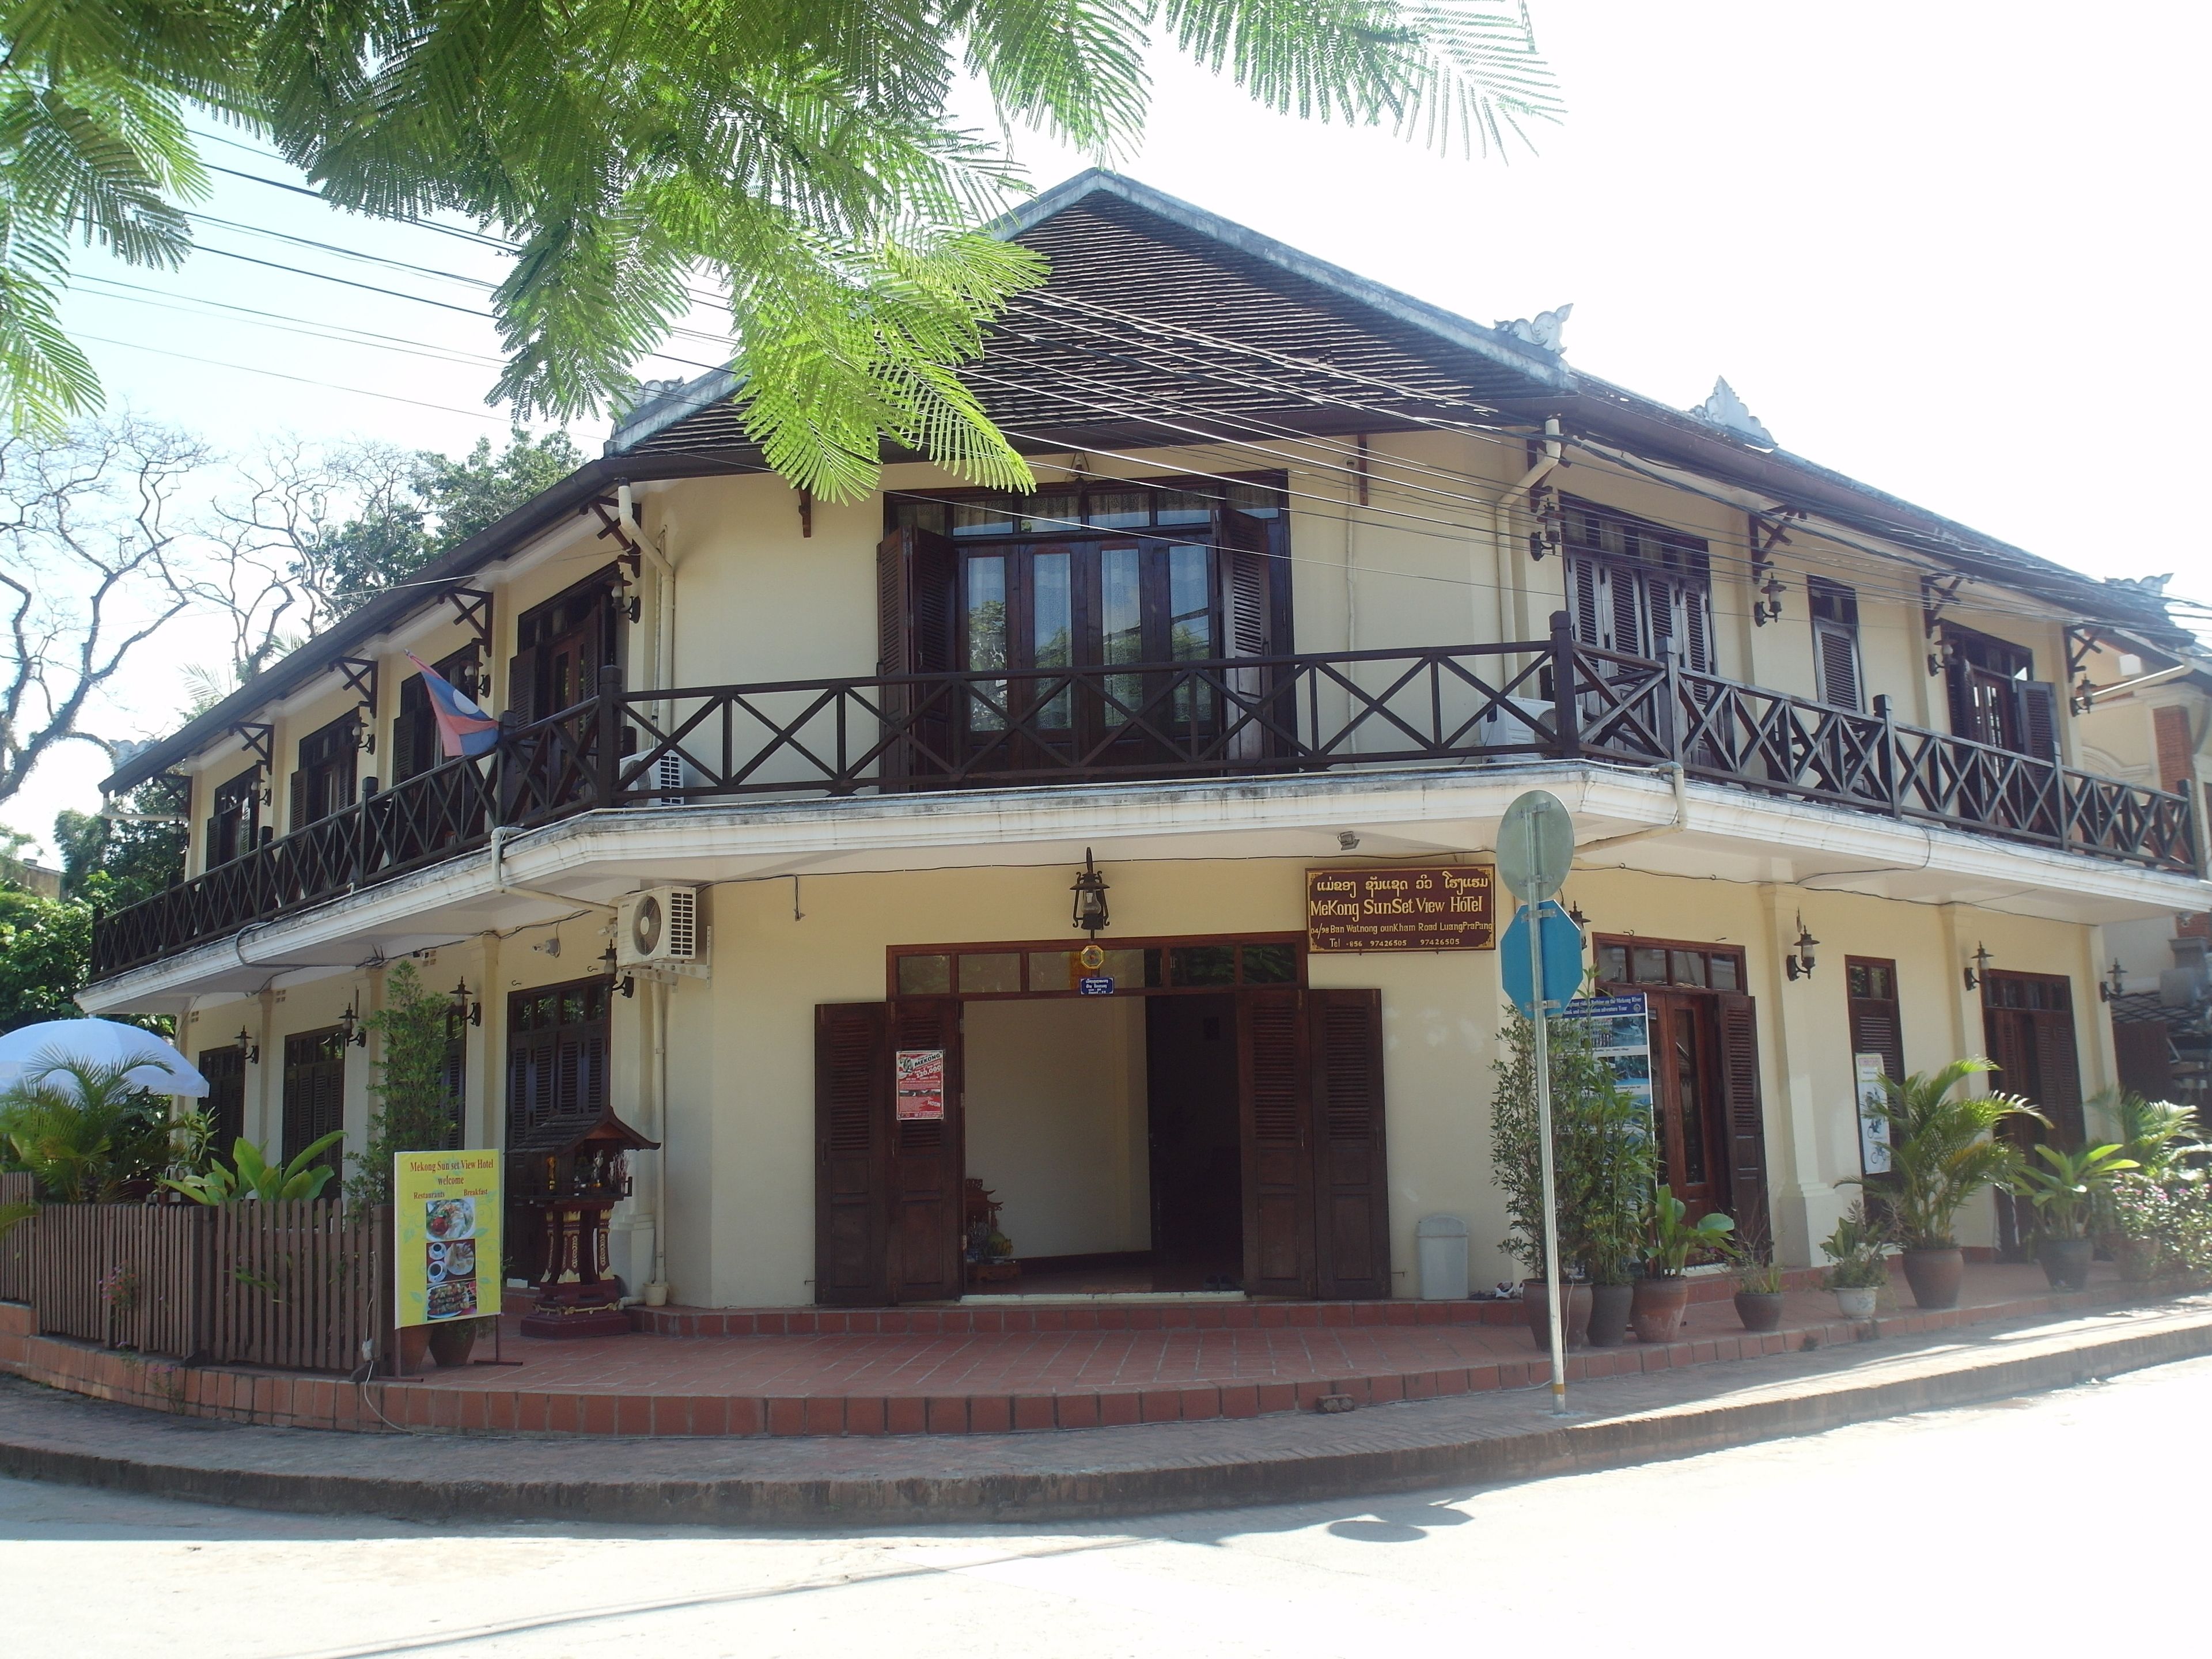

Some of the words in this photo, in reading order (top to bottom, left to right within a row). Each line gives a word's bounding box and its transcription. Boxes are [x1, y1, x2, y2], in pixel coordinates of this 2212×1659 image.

[1310, 900, 1359, 922] MeKong
[1363, 898, 1415, 915] SunSet
[1310, 923, 1329, 939] 04/98
[1330, 925, 1344, 933] Ban
[1418, 922, 1437, 931] Road
[1330, 938, 1340, 948] Tel
[915, 1054, 940, 1066] MEKONG
[410, 1161, 435, 1173] Mekong
[437, 1161, 449, 1171] Sun
[451, 1161, 459, 1170] set
[461, 1160, 476, 1169] View
[478, 1159, 493, 1169] Hotel
[438, 1176, 464, 1185] welcome
[414, 1191, 445, 1199] Restaurants
[464, 1188, 488, 1196] Breakfast
